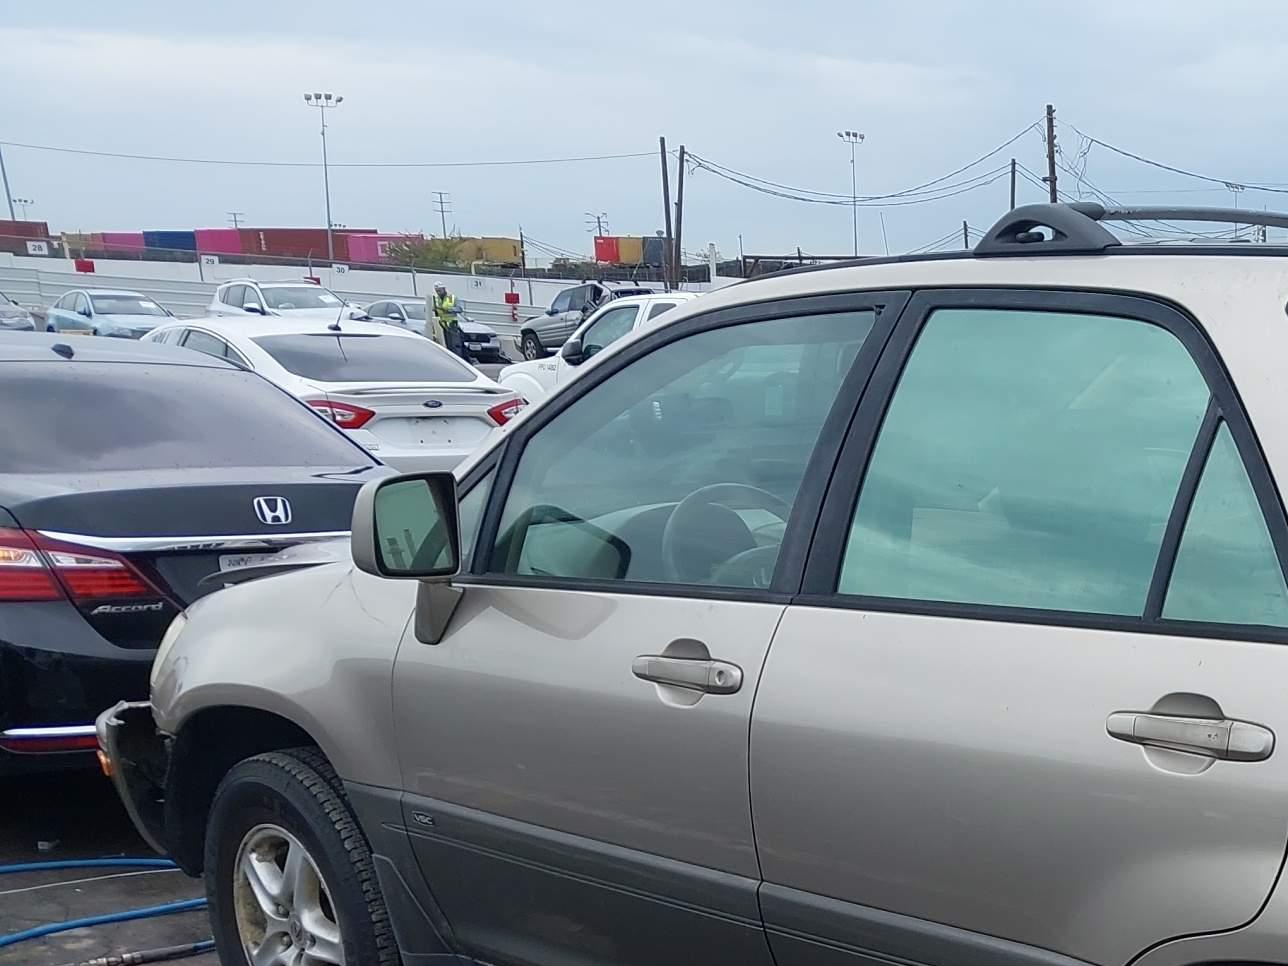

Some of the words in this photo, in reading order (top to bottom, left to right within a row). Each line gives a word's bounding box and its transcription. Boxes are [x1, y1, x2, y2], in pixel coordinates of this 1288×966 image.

[32, 244, 43, 252] 28
[336, 266, 345, 274] 30
[90, 602, 163, 615] Accord
[414, 813, 433, 825] VSC
